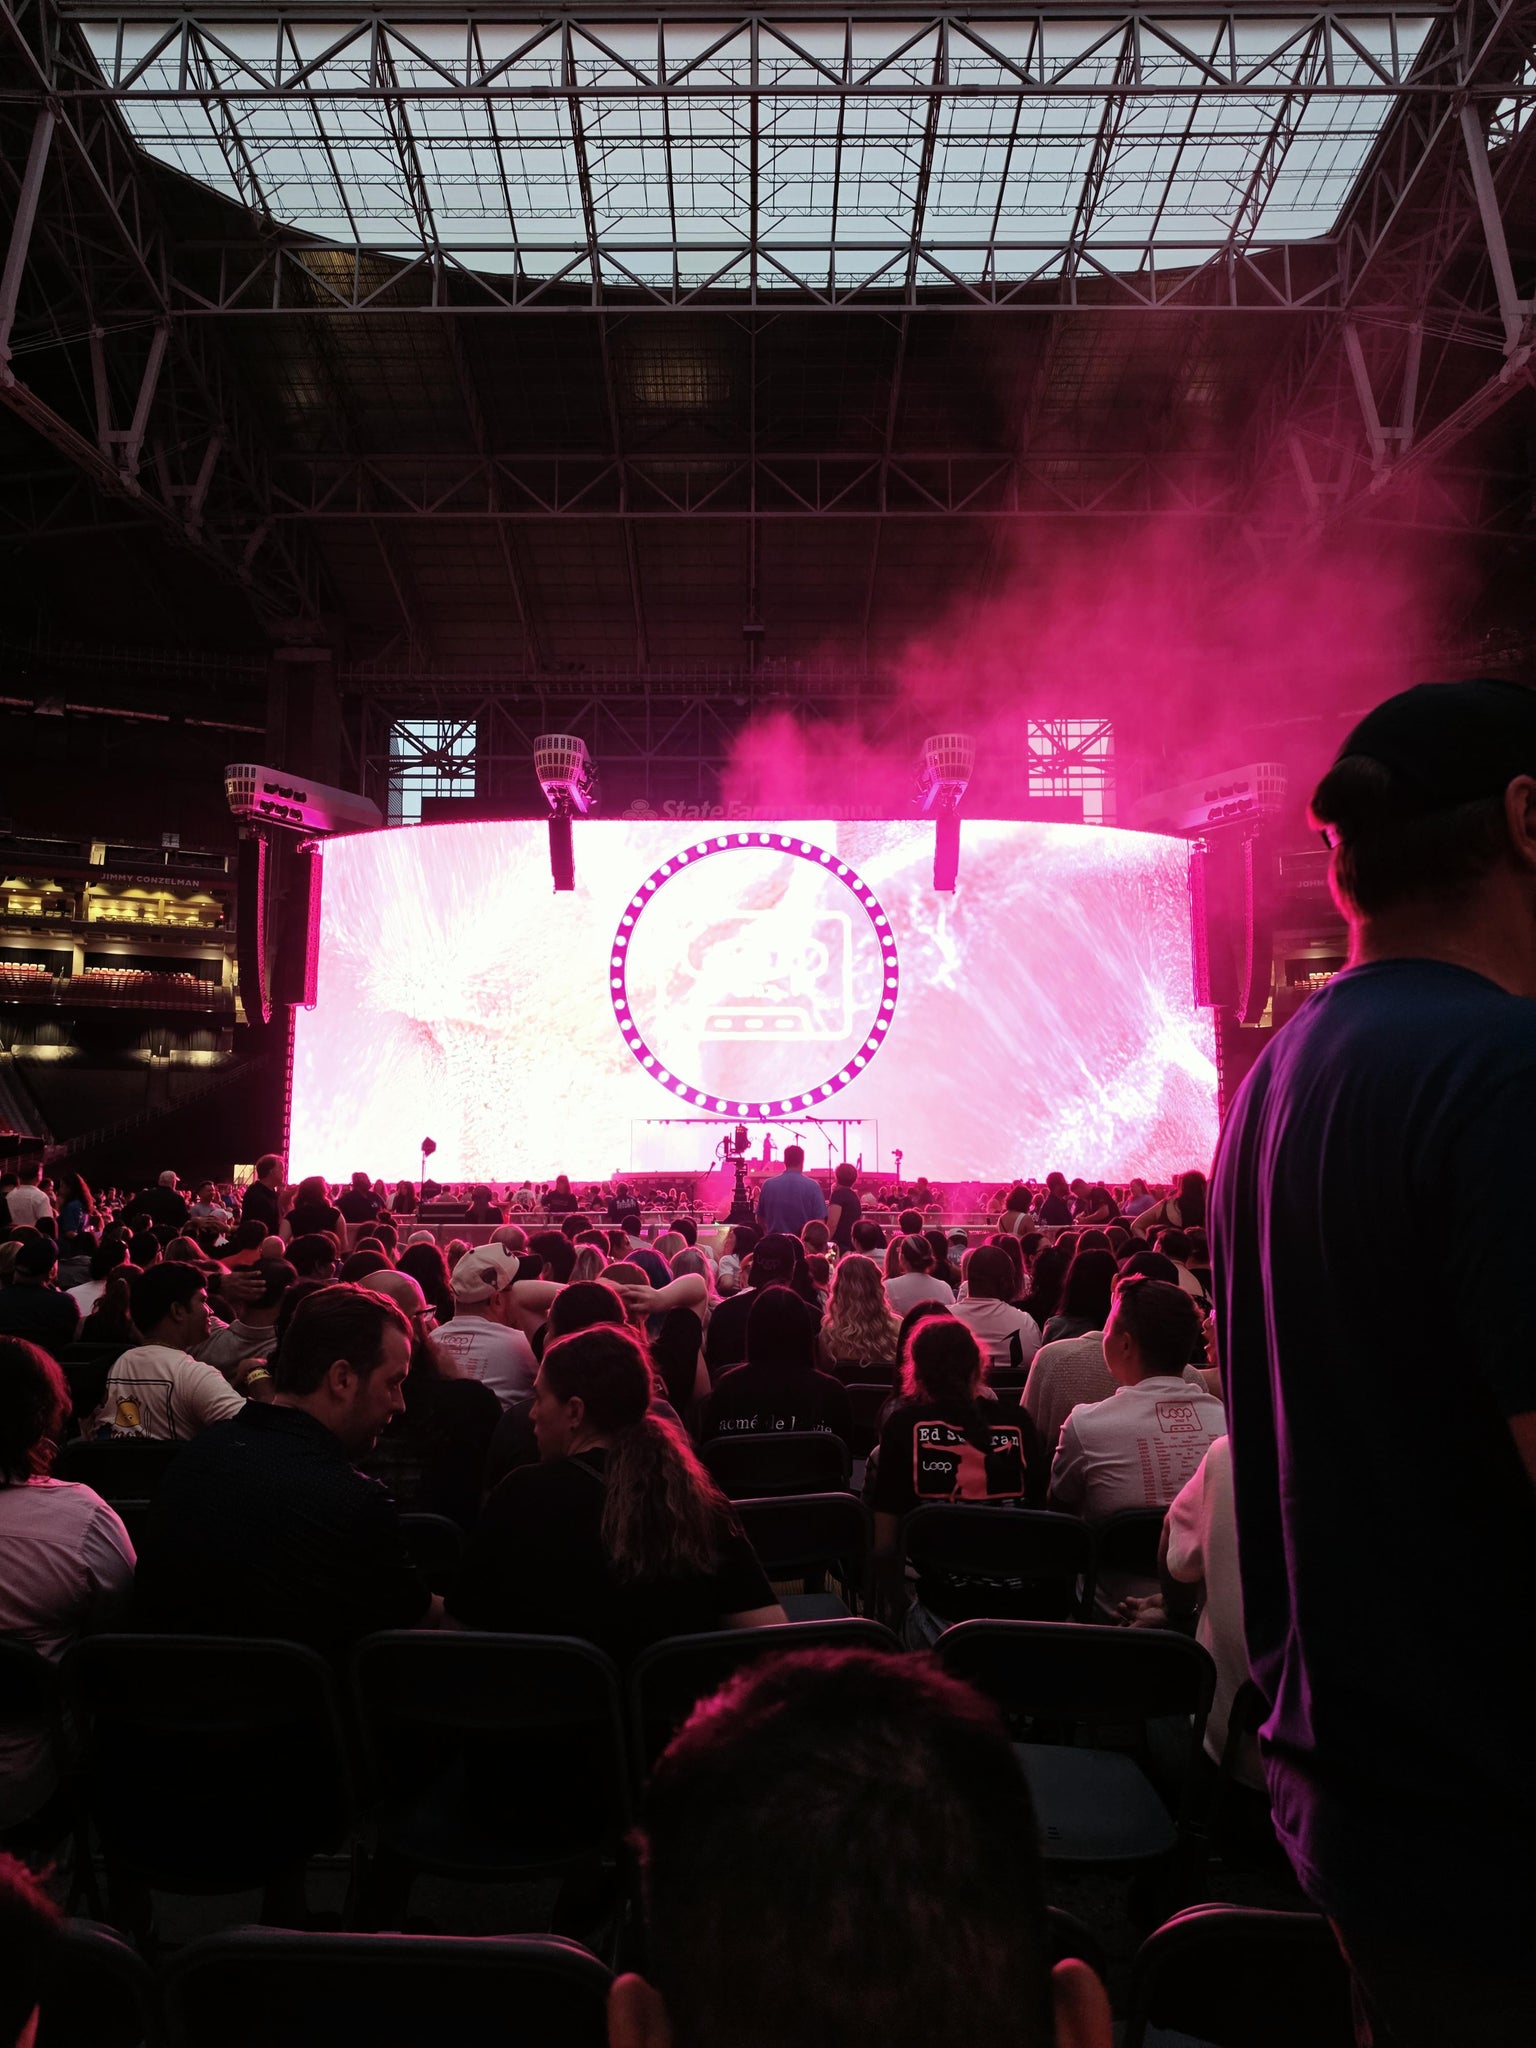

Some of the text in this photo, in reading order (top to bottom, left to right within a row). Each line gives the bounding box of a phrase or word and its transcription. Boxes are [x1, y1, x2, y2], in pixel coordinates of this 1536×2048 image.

[101, 872, 200, 887] JIMMY CONZELMAN
[719, 1414, 759, 1431] acmé
[919, 1428, 1020, 1447] Ed Sran
